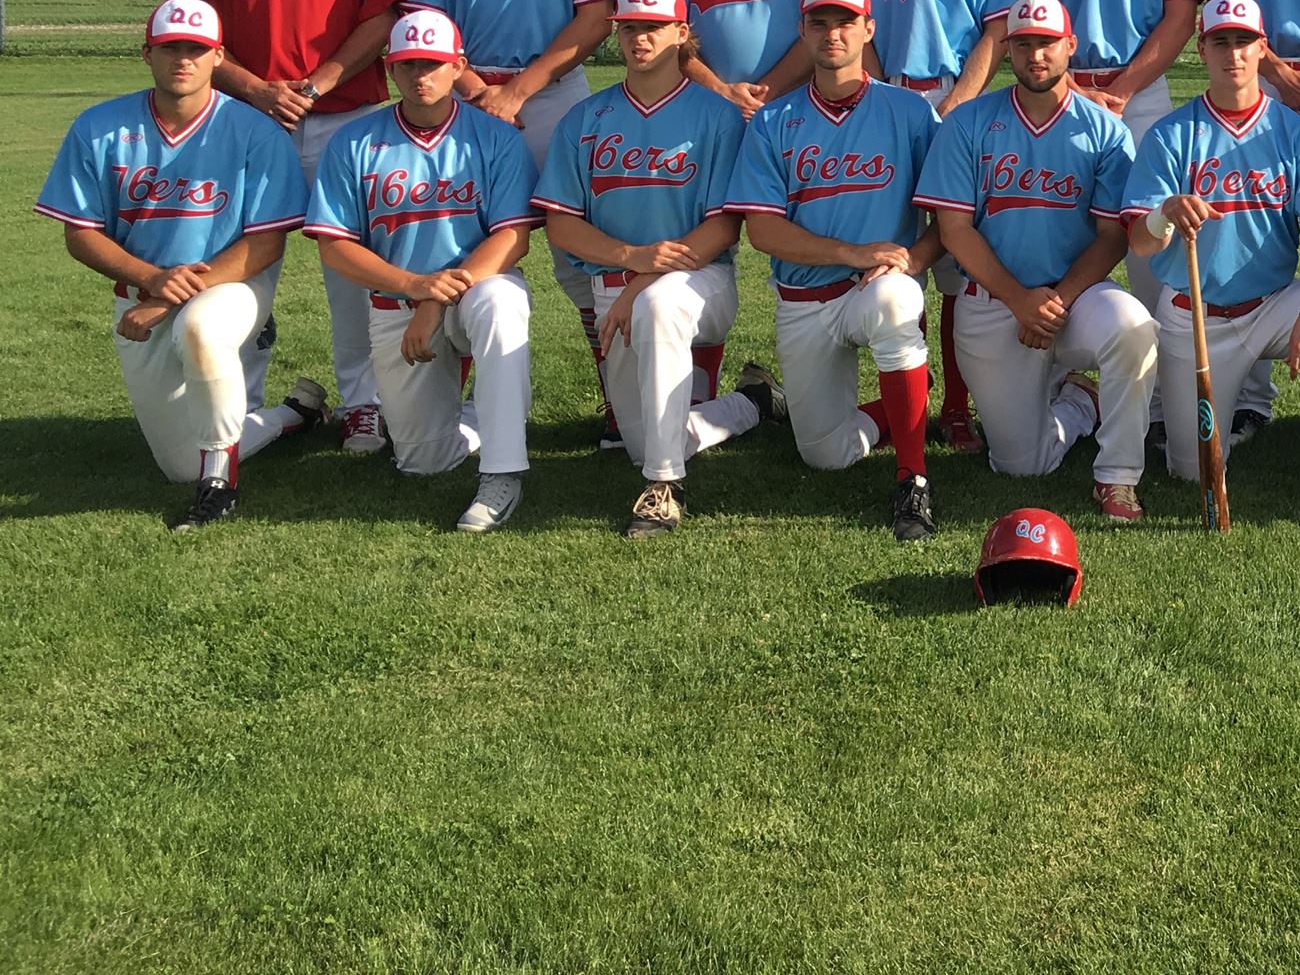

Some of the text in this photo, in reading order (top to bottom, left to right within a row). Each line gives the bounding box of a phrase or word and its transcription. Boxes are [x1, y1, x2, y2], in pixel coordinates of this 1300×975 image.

[579, 133, 697, 179] 76ers
[980, 152, 1082, 198] 76ers
[113, 164, 228, 206] 76ers
[361, 169, 483, 211] 76ers
[1015, 519, 1046, 543] QC
